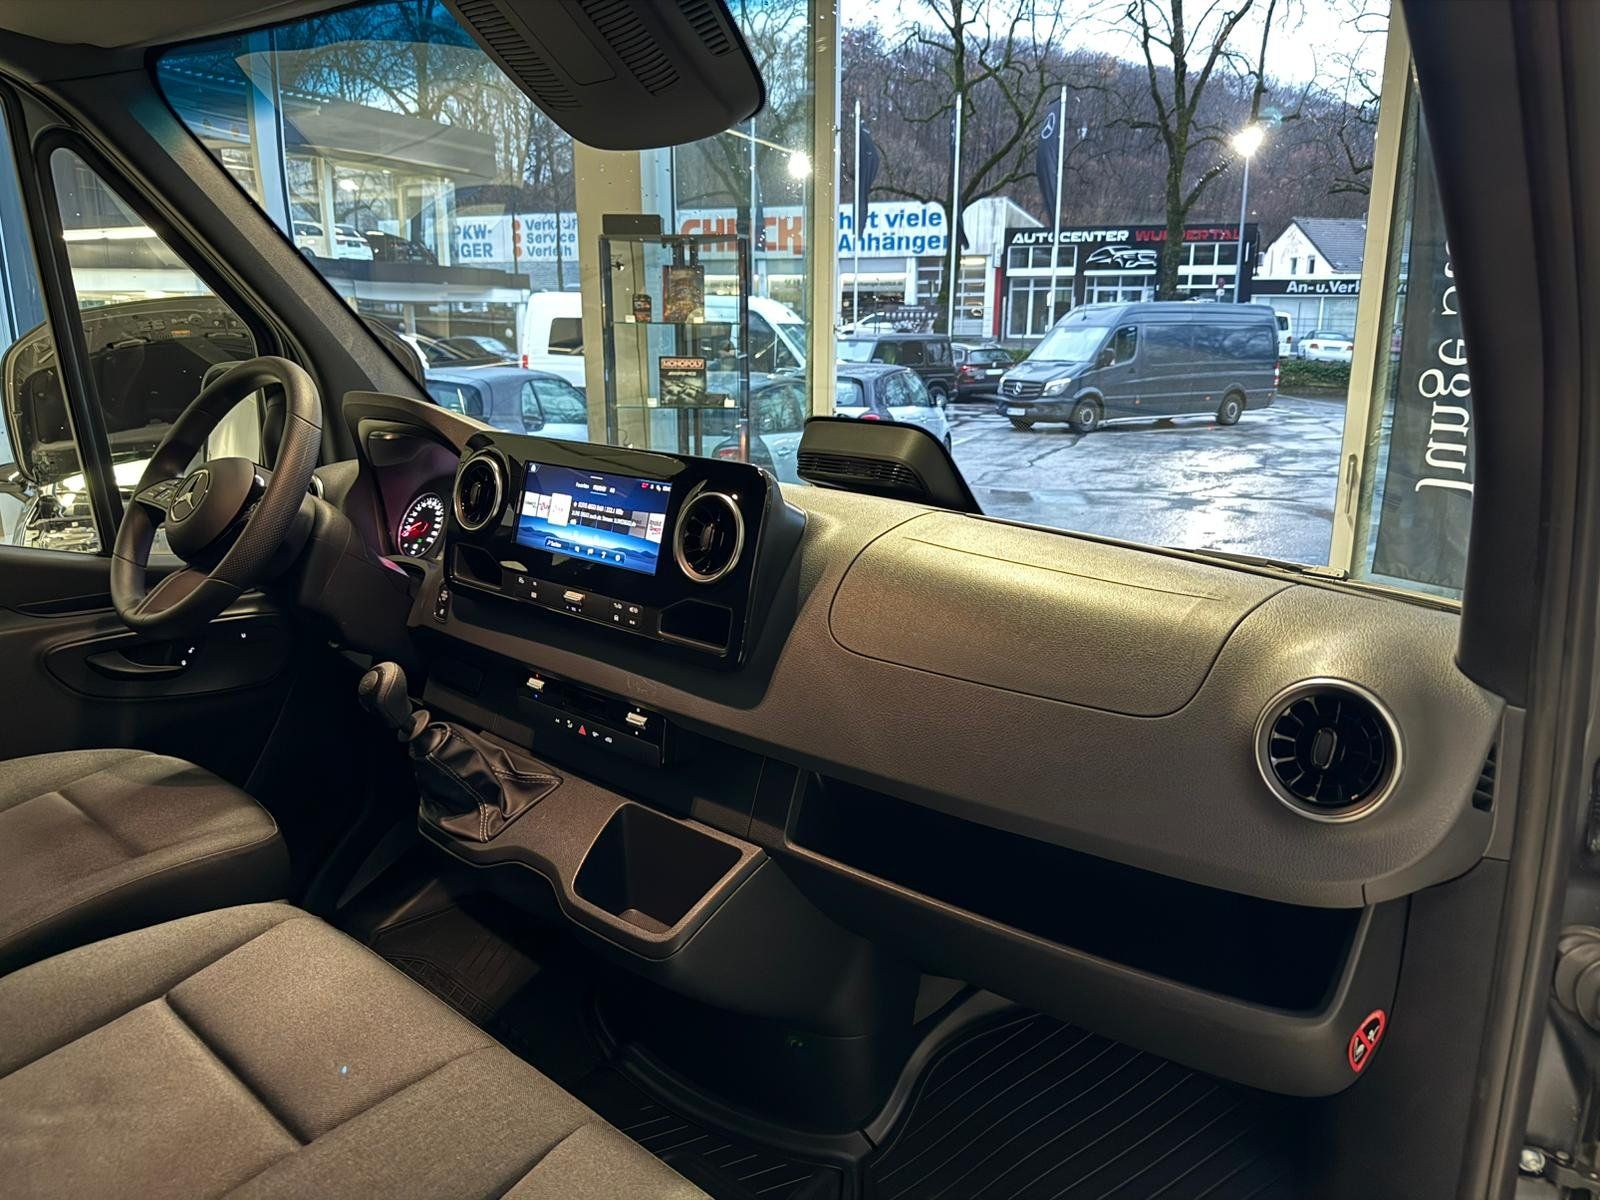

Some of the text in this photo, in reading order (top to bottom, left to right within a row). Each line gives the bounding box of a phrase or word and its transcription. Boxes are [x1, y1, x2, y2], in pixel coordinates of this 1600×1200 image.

[885, 203, 942, 230] viele
[525, 218, 577, 231] Verkuf
[526, 232, 576, 244] Servce
[1136, 228, 1240, 241] WUERTAL
[526, 245, 572, 257] Verleh
